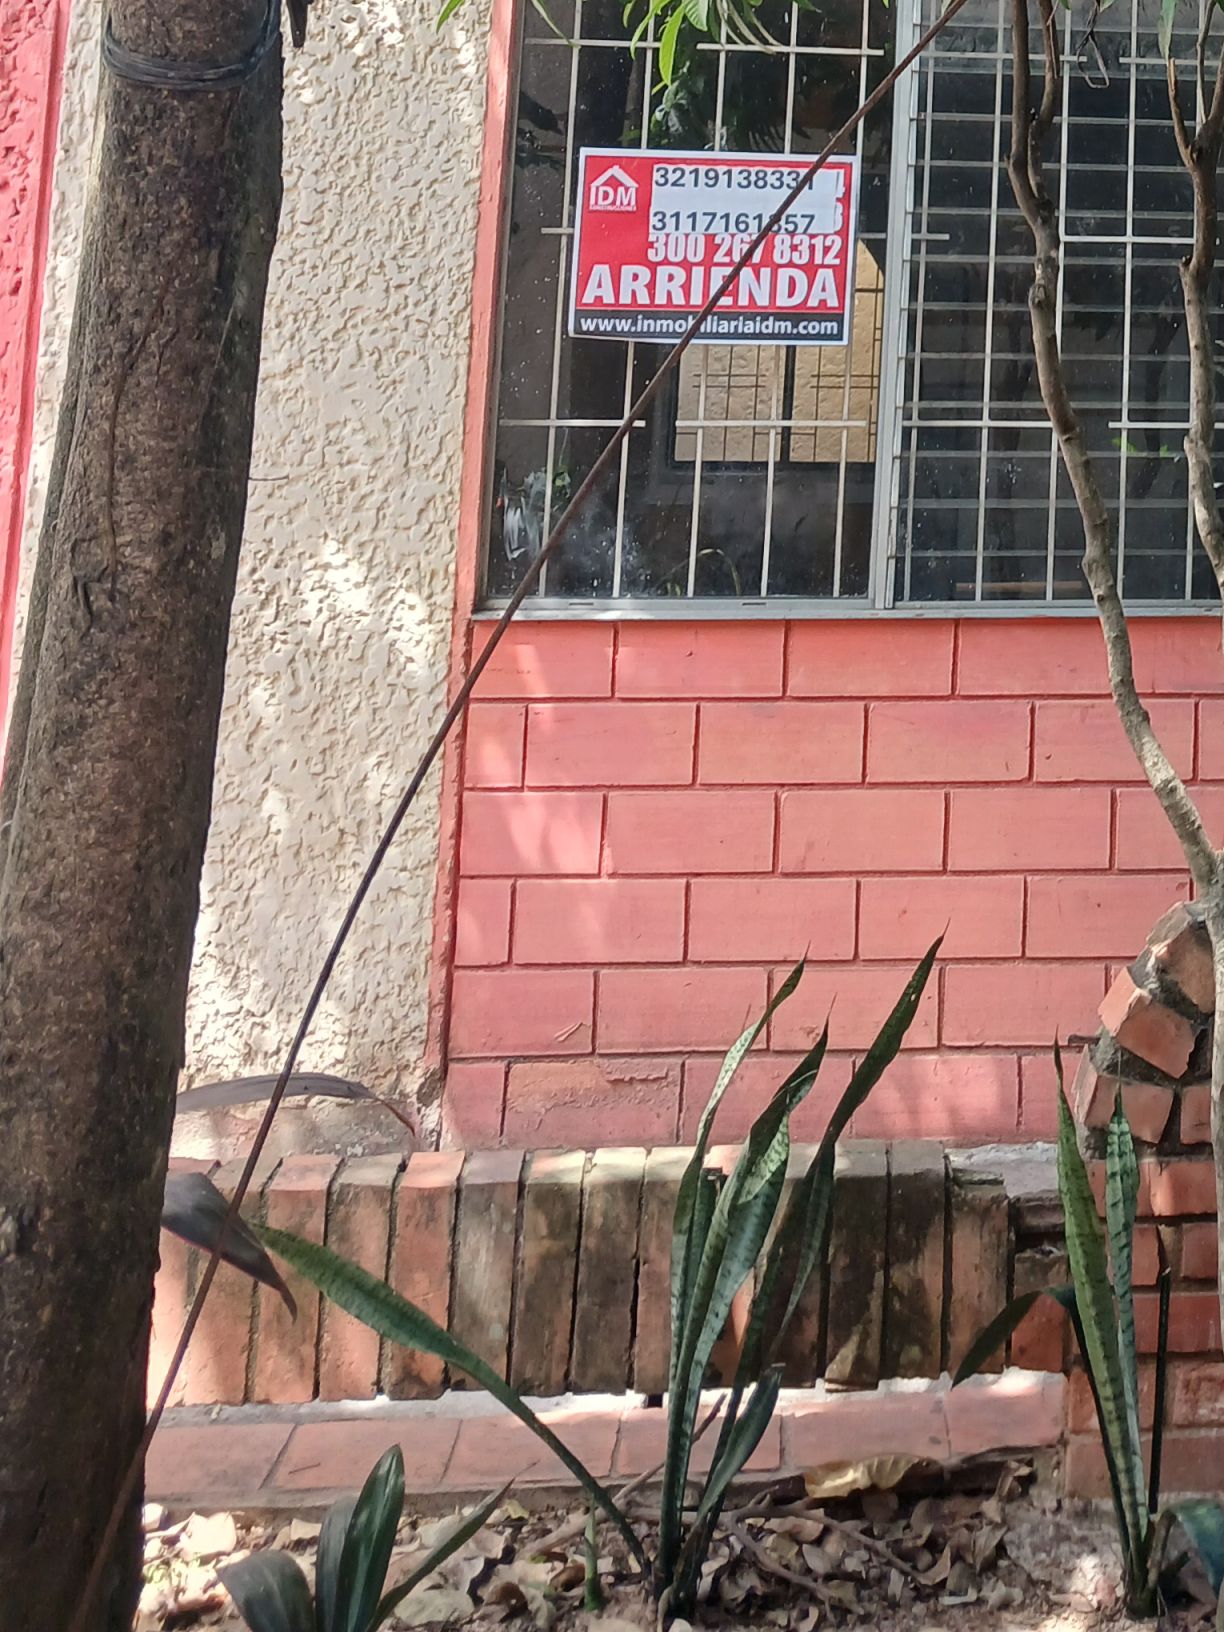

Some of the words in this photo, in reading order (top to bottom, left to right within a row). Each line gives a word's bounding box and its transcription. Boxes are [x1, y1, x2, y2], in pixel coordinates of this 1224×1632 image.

[654, 166, 814, 191] 3219138331
[589, 185, 637, 206] IDM
[647, 232, 705, 262] 300
[713, 234, 765, 264] 267
[773, 234, 843, 265] 8312
[581, 263, 839, 308] ARRIENDA
